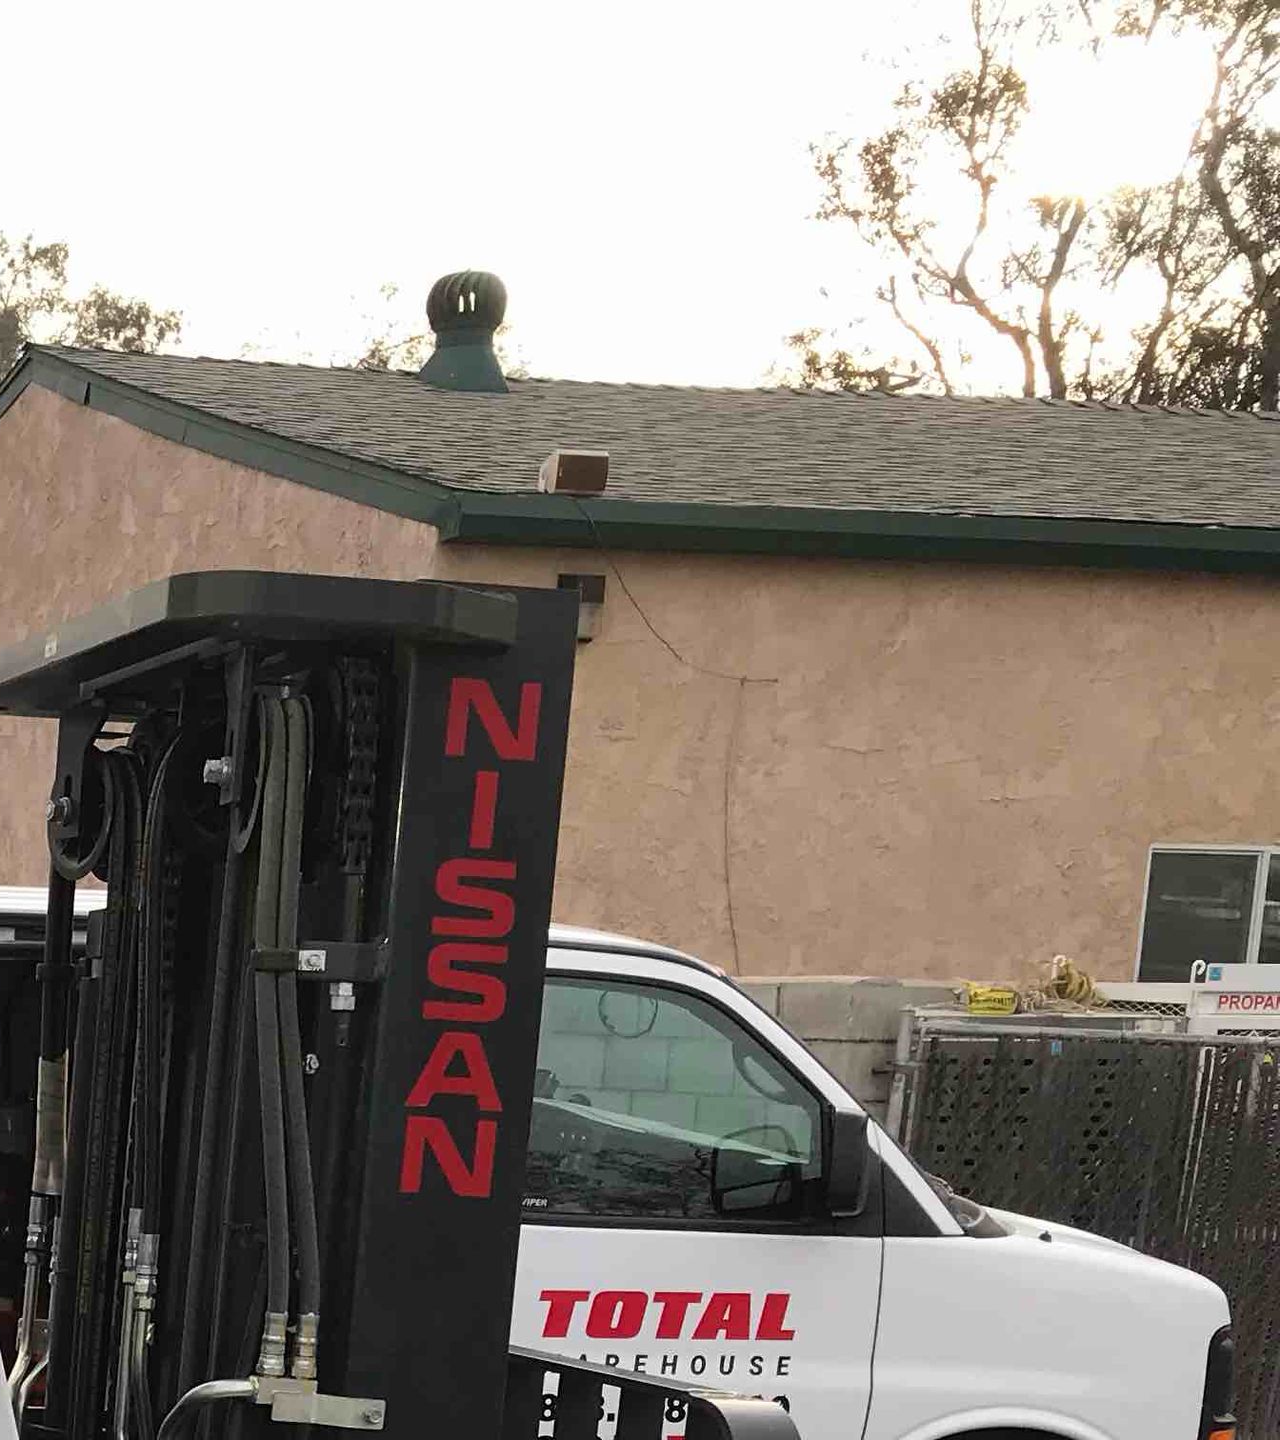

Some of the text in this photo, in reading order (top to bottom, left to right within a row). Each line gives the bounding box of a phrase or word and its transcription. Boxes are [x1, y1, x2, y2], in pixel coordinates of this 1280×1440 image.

[399, 676, 543, 1198] NISSAN
[538, 1290, 796, 1341] TOTAL
[578, 1353, 792, 1377] REHOUSE
